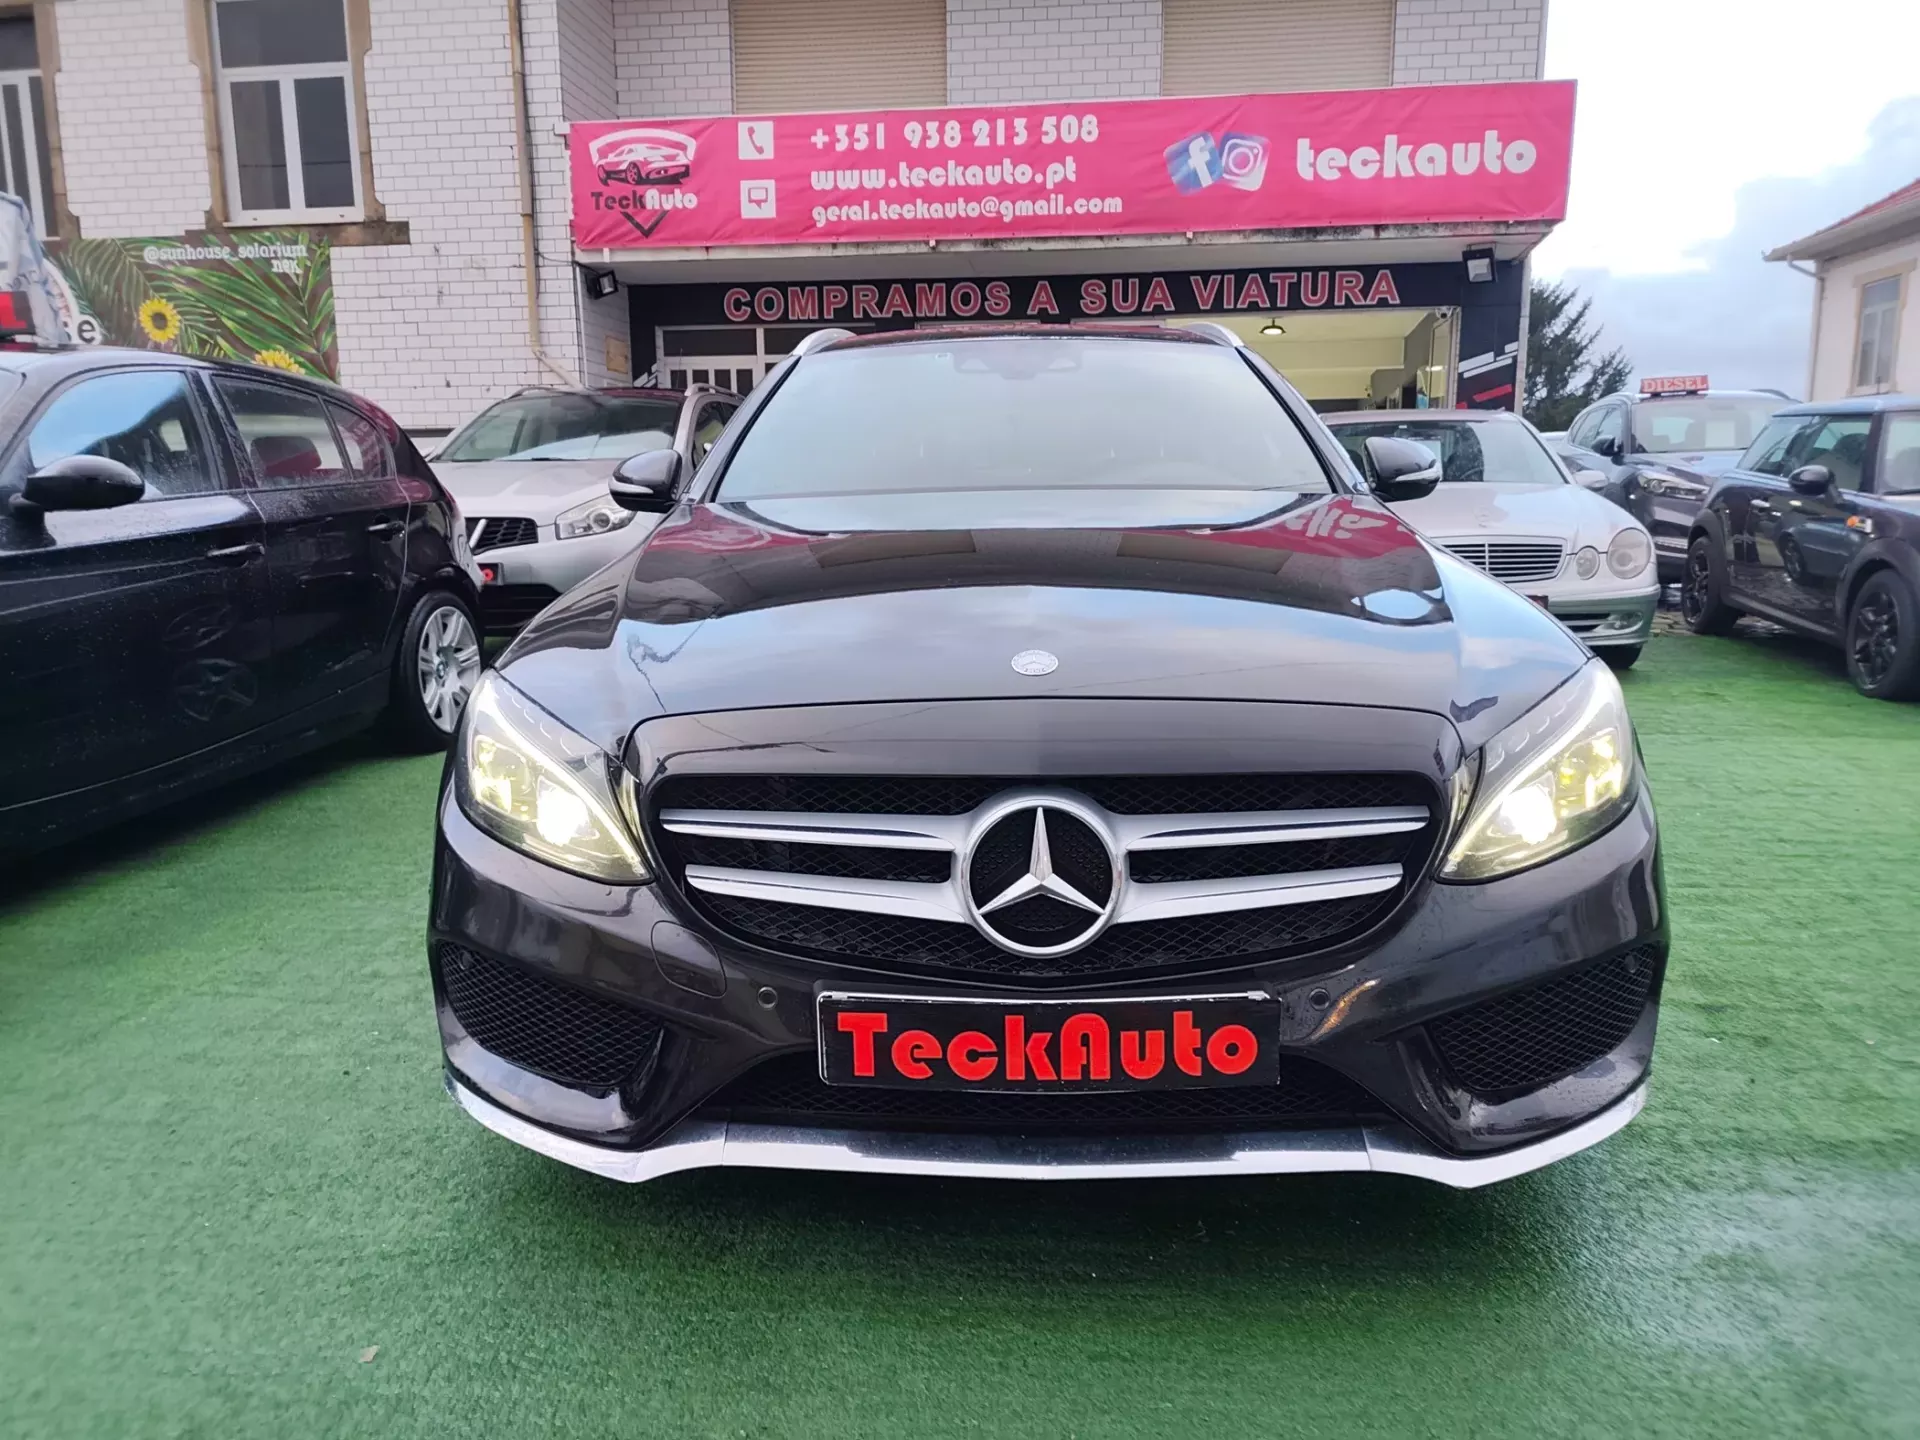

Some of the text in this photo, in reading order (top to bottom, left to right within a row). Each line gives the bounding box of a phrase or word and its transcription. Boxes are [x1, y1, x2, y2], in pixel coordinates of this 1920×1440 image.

[810, 114, 1100, 151] +351 938 213 508
[810, 155, 1077, 190] www.teckauto.pt
[1296, 130, 1538, 181] teckauto
[590, 187, 698, 211] TeckAuto
[811, 193, 1123, 229] geral.teckauto@gmail.com
[723, 269, 1401, 322] COMPRAMOS A SUA VIATURA
[1642, 376, 1707, 393] DIESEL
[836, 1010, 1259, 1082] TeckAuto
